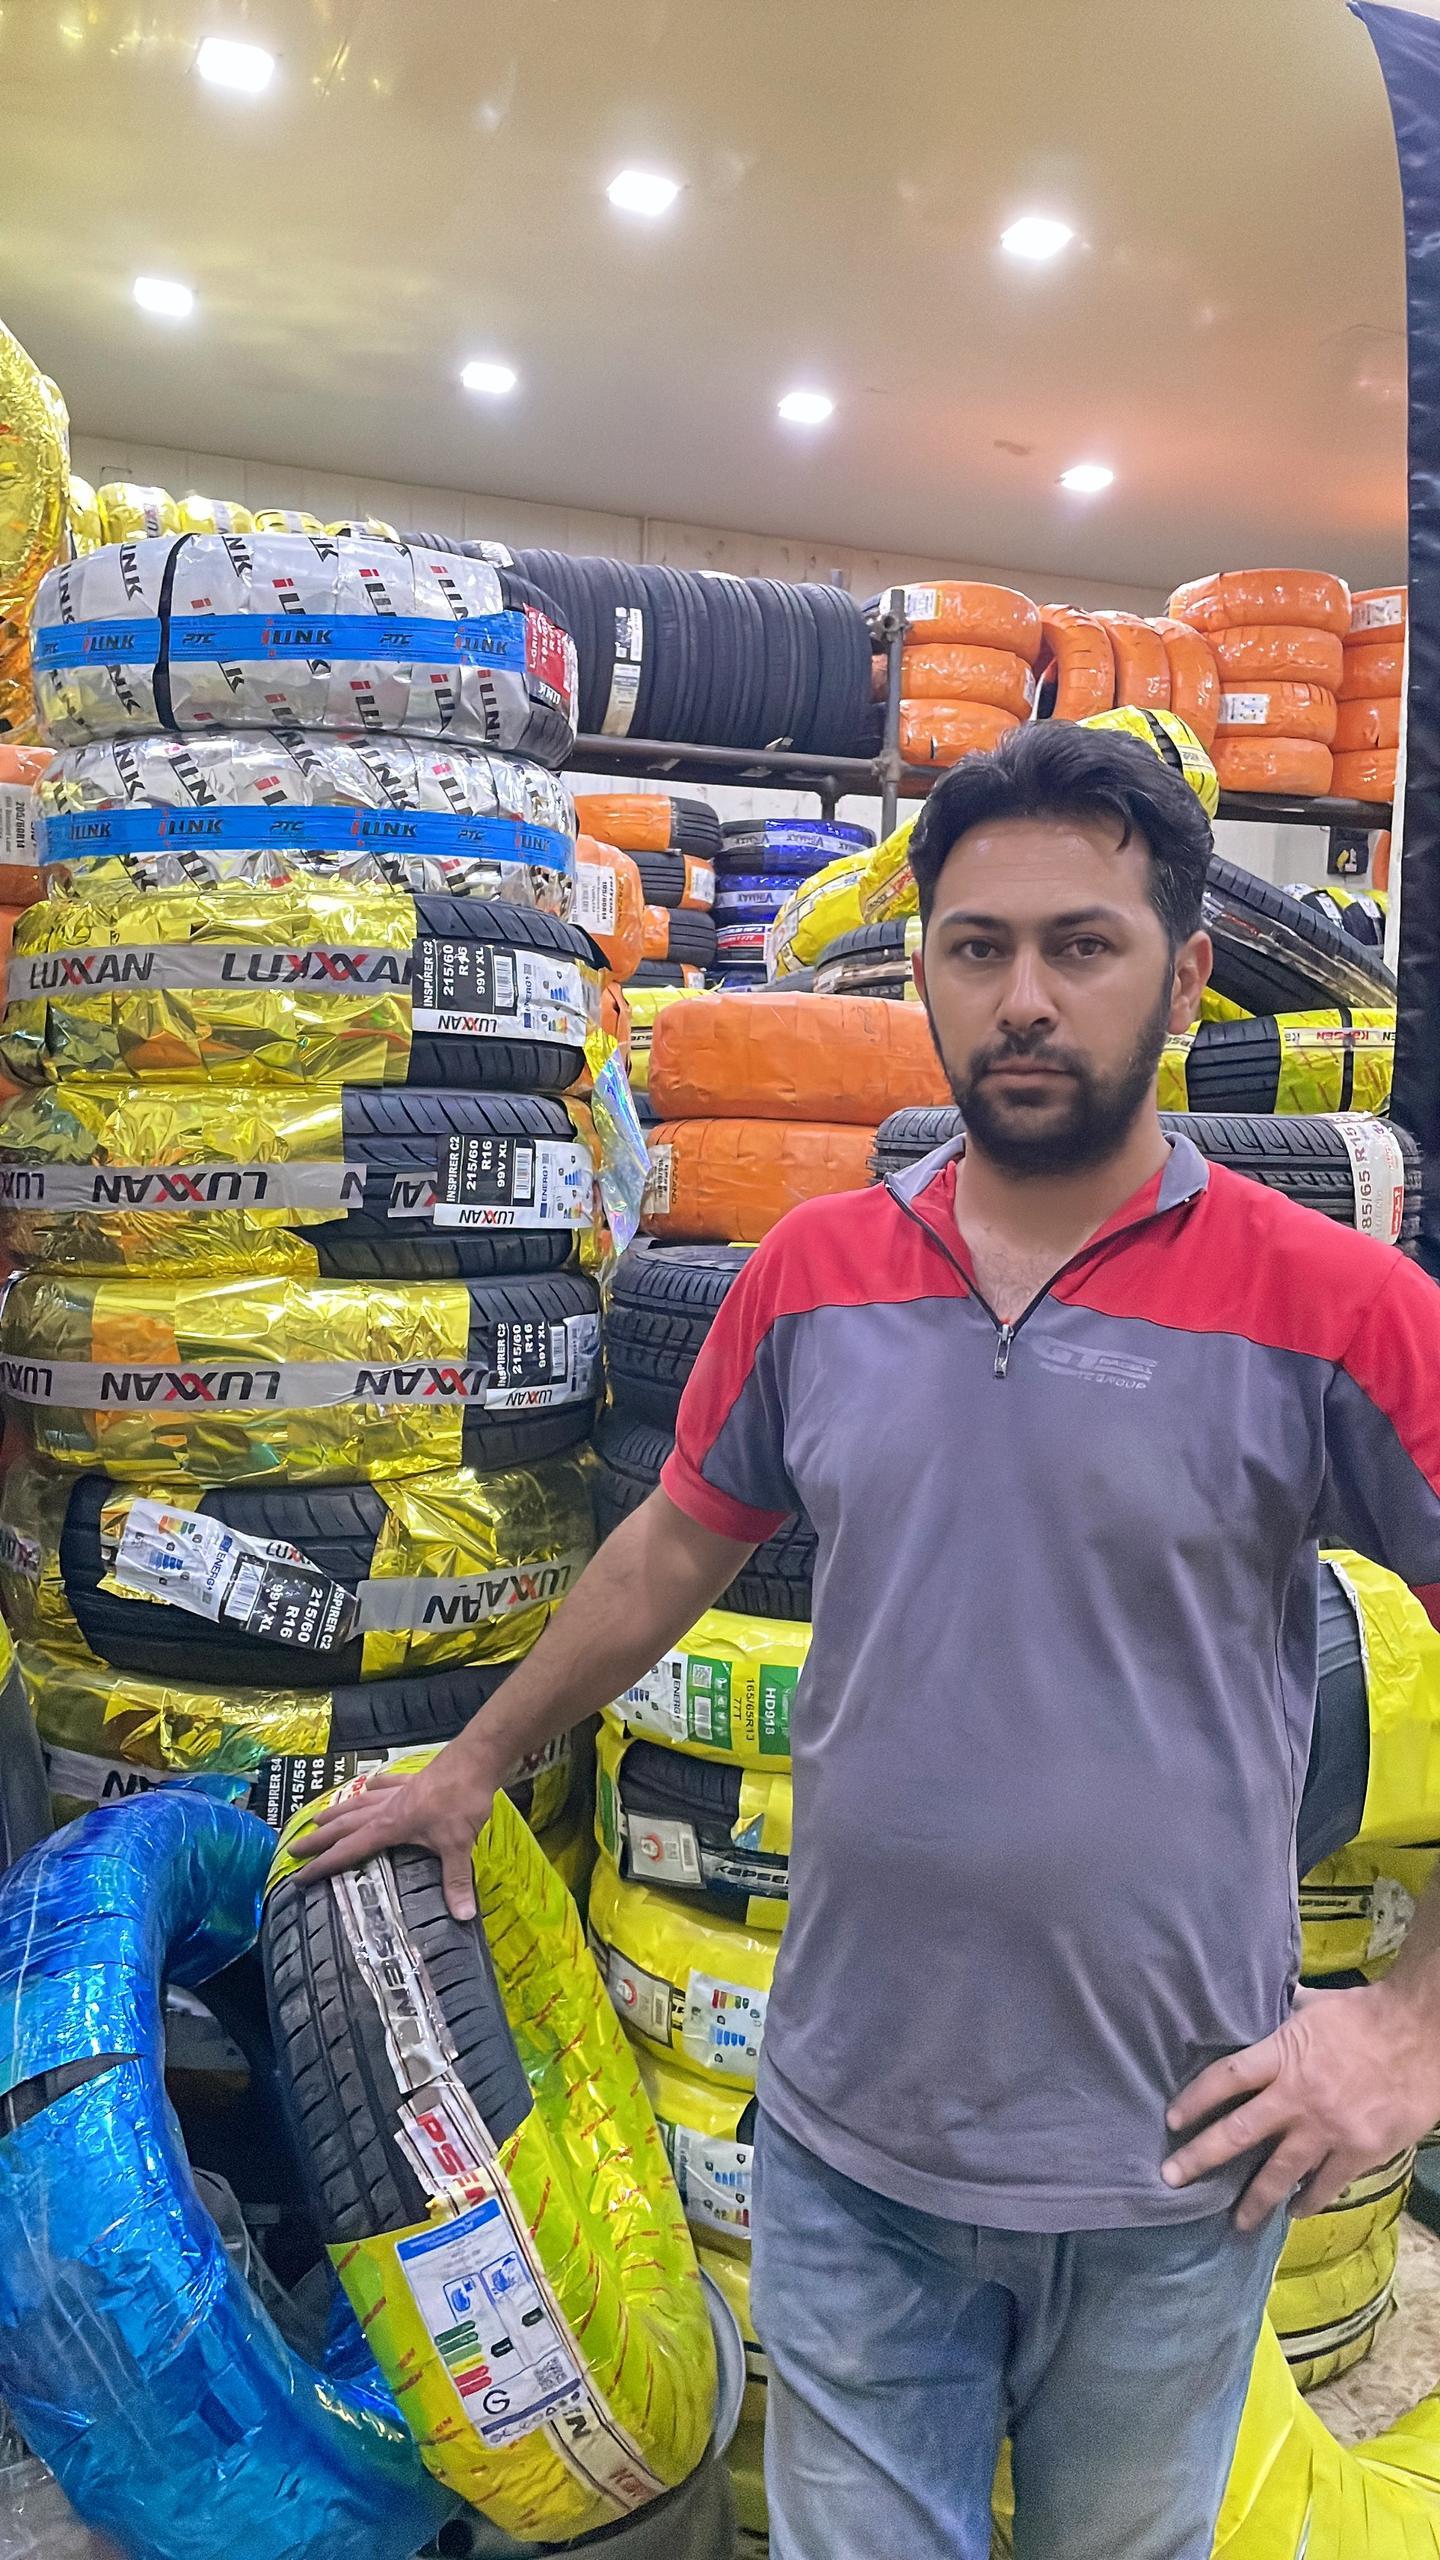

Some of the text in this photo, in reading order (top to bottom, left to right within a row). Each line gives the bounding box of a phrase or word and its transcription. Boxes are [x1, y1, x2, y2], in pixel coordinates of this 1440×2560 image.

[30, 952, 154, 991] LUXXAN
[422, 940, 434, 1007] INSPIRER C2
[442, 944, 455, 997] 215/60
[475, 946, 486, 995] 99V XL
[437, 1015, 498, 1034] LUXXAN
[466, 1139, 479, 1191] 215/60
[481, 1140, 493, 1171] R16
[496, 1140, 508, 1188] 99V XL
[1347, 1125, 1369, 1163] R15
[92, 1171, 269, 1204] LUXXAN
[446, 1135, 461, 1204] INSPIRER C2
[458, 1209, 515, 1225] LUXXAN
[1361, 1168, 1374, 1237] 85/65
[496, 1322, 508, 1388] INSPIRER C2
[512, 1323, 524, 1376] 215/60
[523, 1322, 534, 1353] R16
[100, 1371, 282, 1401] LUXXAN
[353, 1367, 491, 1396] UXXAN
[505, 1389, 553, 1407] LUXXAN
[257, 1613, 277, 1634] XL
[278, 1604, 301, 1639] R16
[296, 1586, 324, 1643] 215/60
[732, 1696, 743, 1721] 77T
[745, 1677, 756, 1742] 165/65R13
[765, 1687, 777, 1736] HD918
[290, 1758, 307, 1814] 215/55
[311, 1757, 326, 1791] R18
[267, 1772, 283, 1827] INSPIRER
